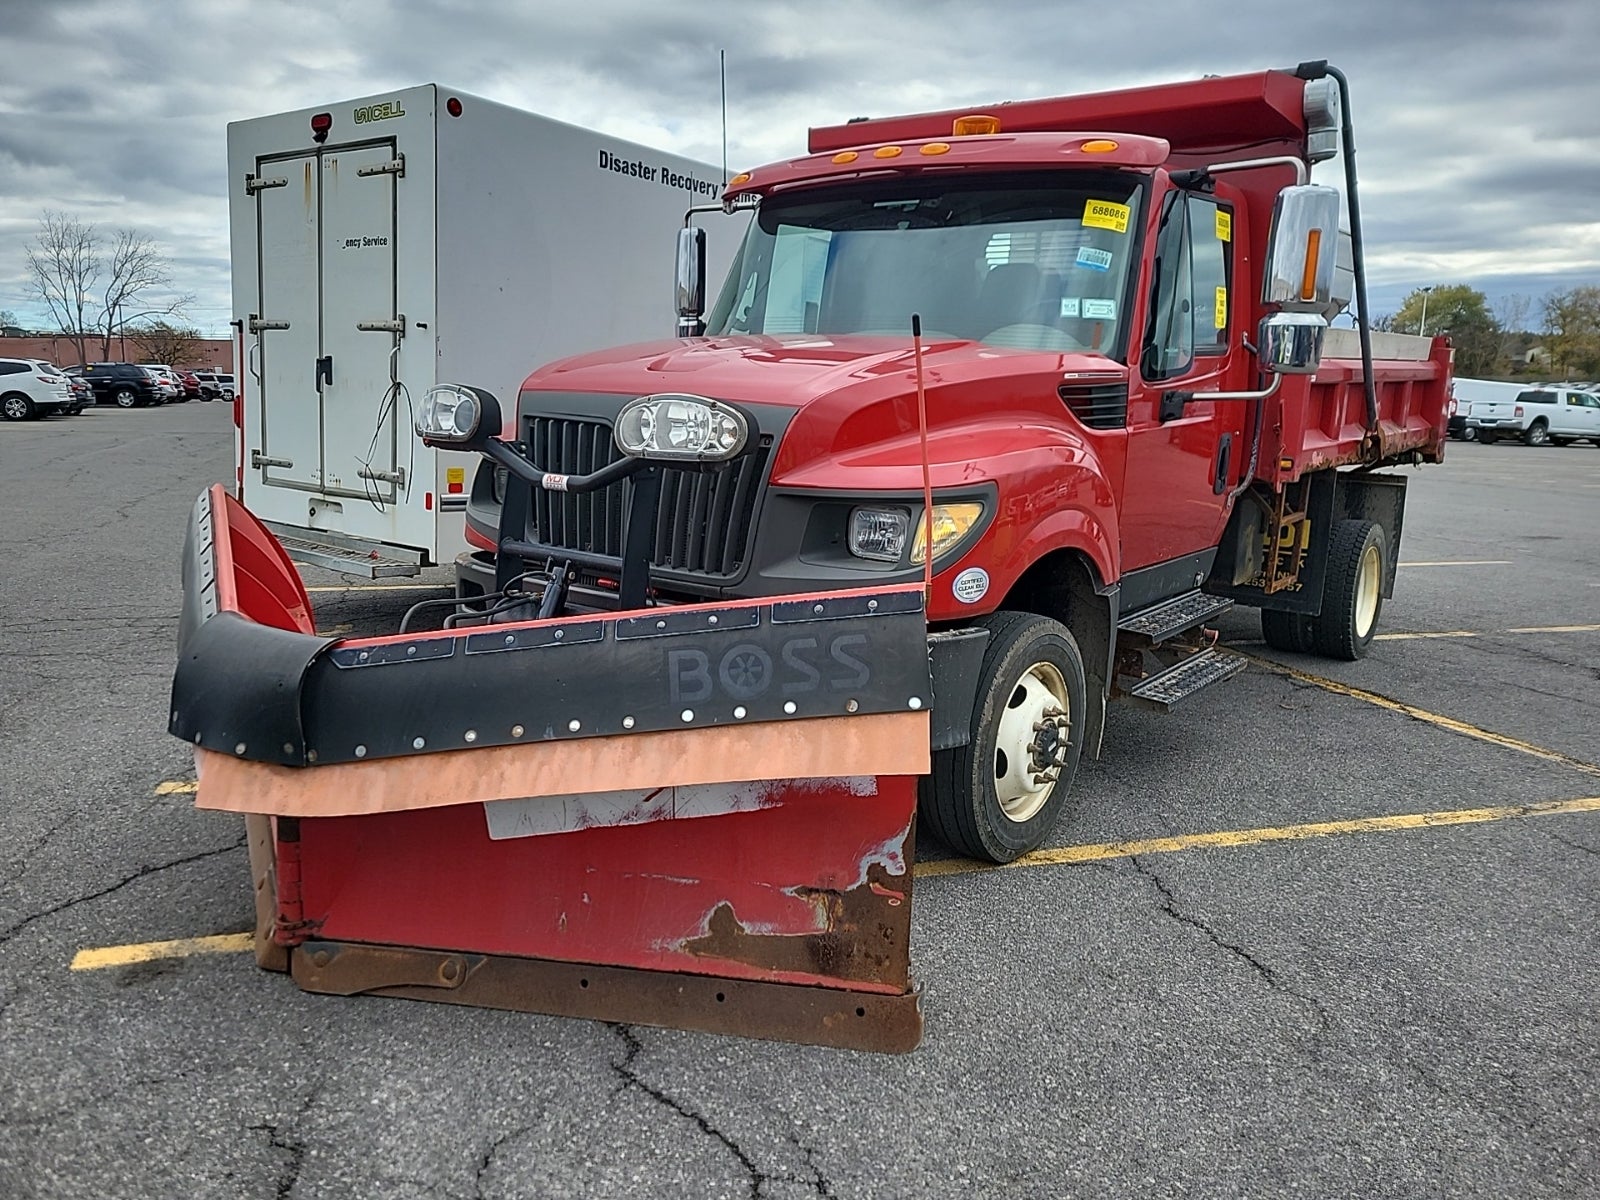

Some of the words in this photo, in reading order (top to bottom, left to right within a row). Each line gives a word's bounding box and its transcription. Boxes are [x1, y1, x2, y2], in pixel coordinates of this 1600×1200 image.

[599, 149, 657, 182] Disaster
[661, 166, 719, 200] Recovery
[1092, 206, 1127, 220] 688086
[362, 236, 388, 247] Service
[961, 577, 984, 586] CERTIFIED
[958, 584, 975, 592] CLEAN
[667, 632, 872, 704] BOSS
